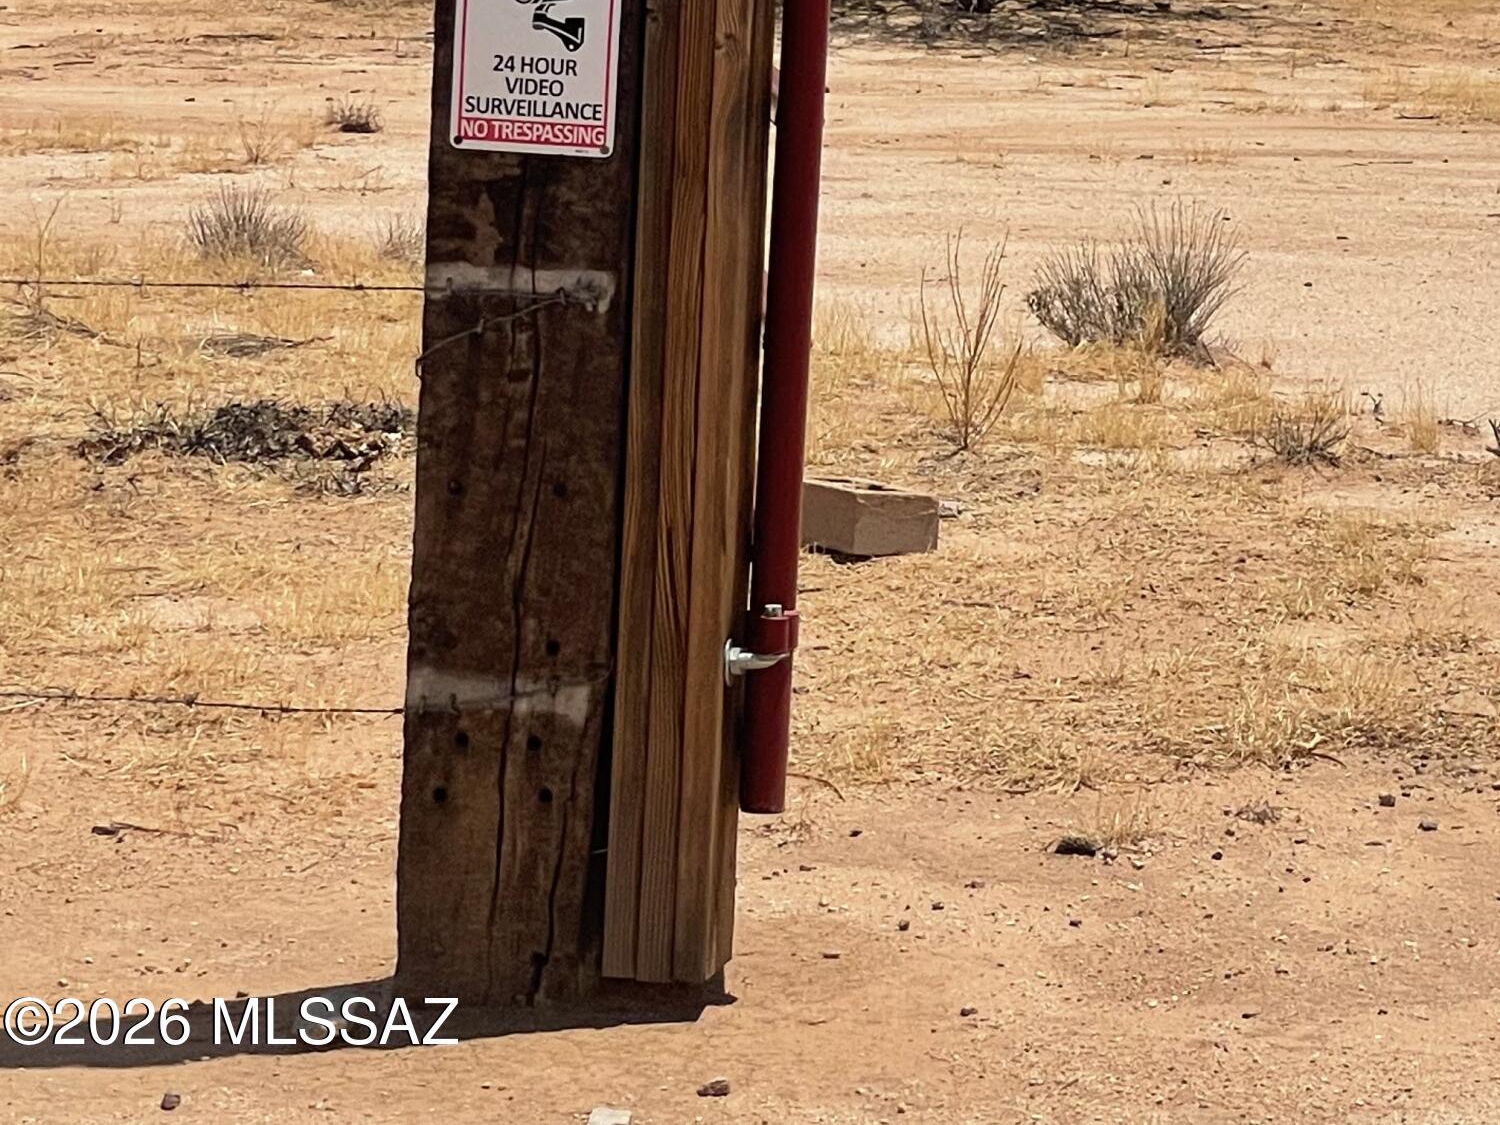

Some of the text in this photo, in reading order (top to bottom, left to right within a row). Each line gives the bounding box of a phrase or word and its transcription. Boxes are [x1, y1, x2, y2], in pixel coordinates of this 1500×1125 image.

[492, 54, 578, 76] 24 HOUR
[505, 76, 564, 97] VIDEO
[464, 95, 603, 121] SURVEILLANCE
[460, 119, 606, 145] NO TRESPASSING
